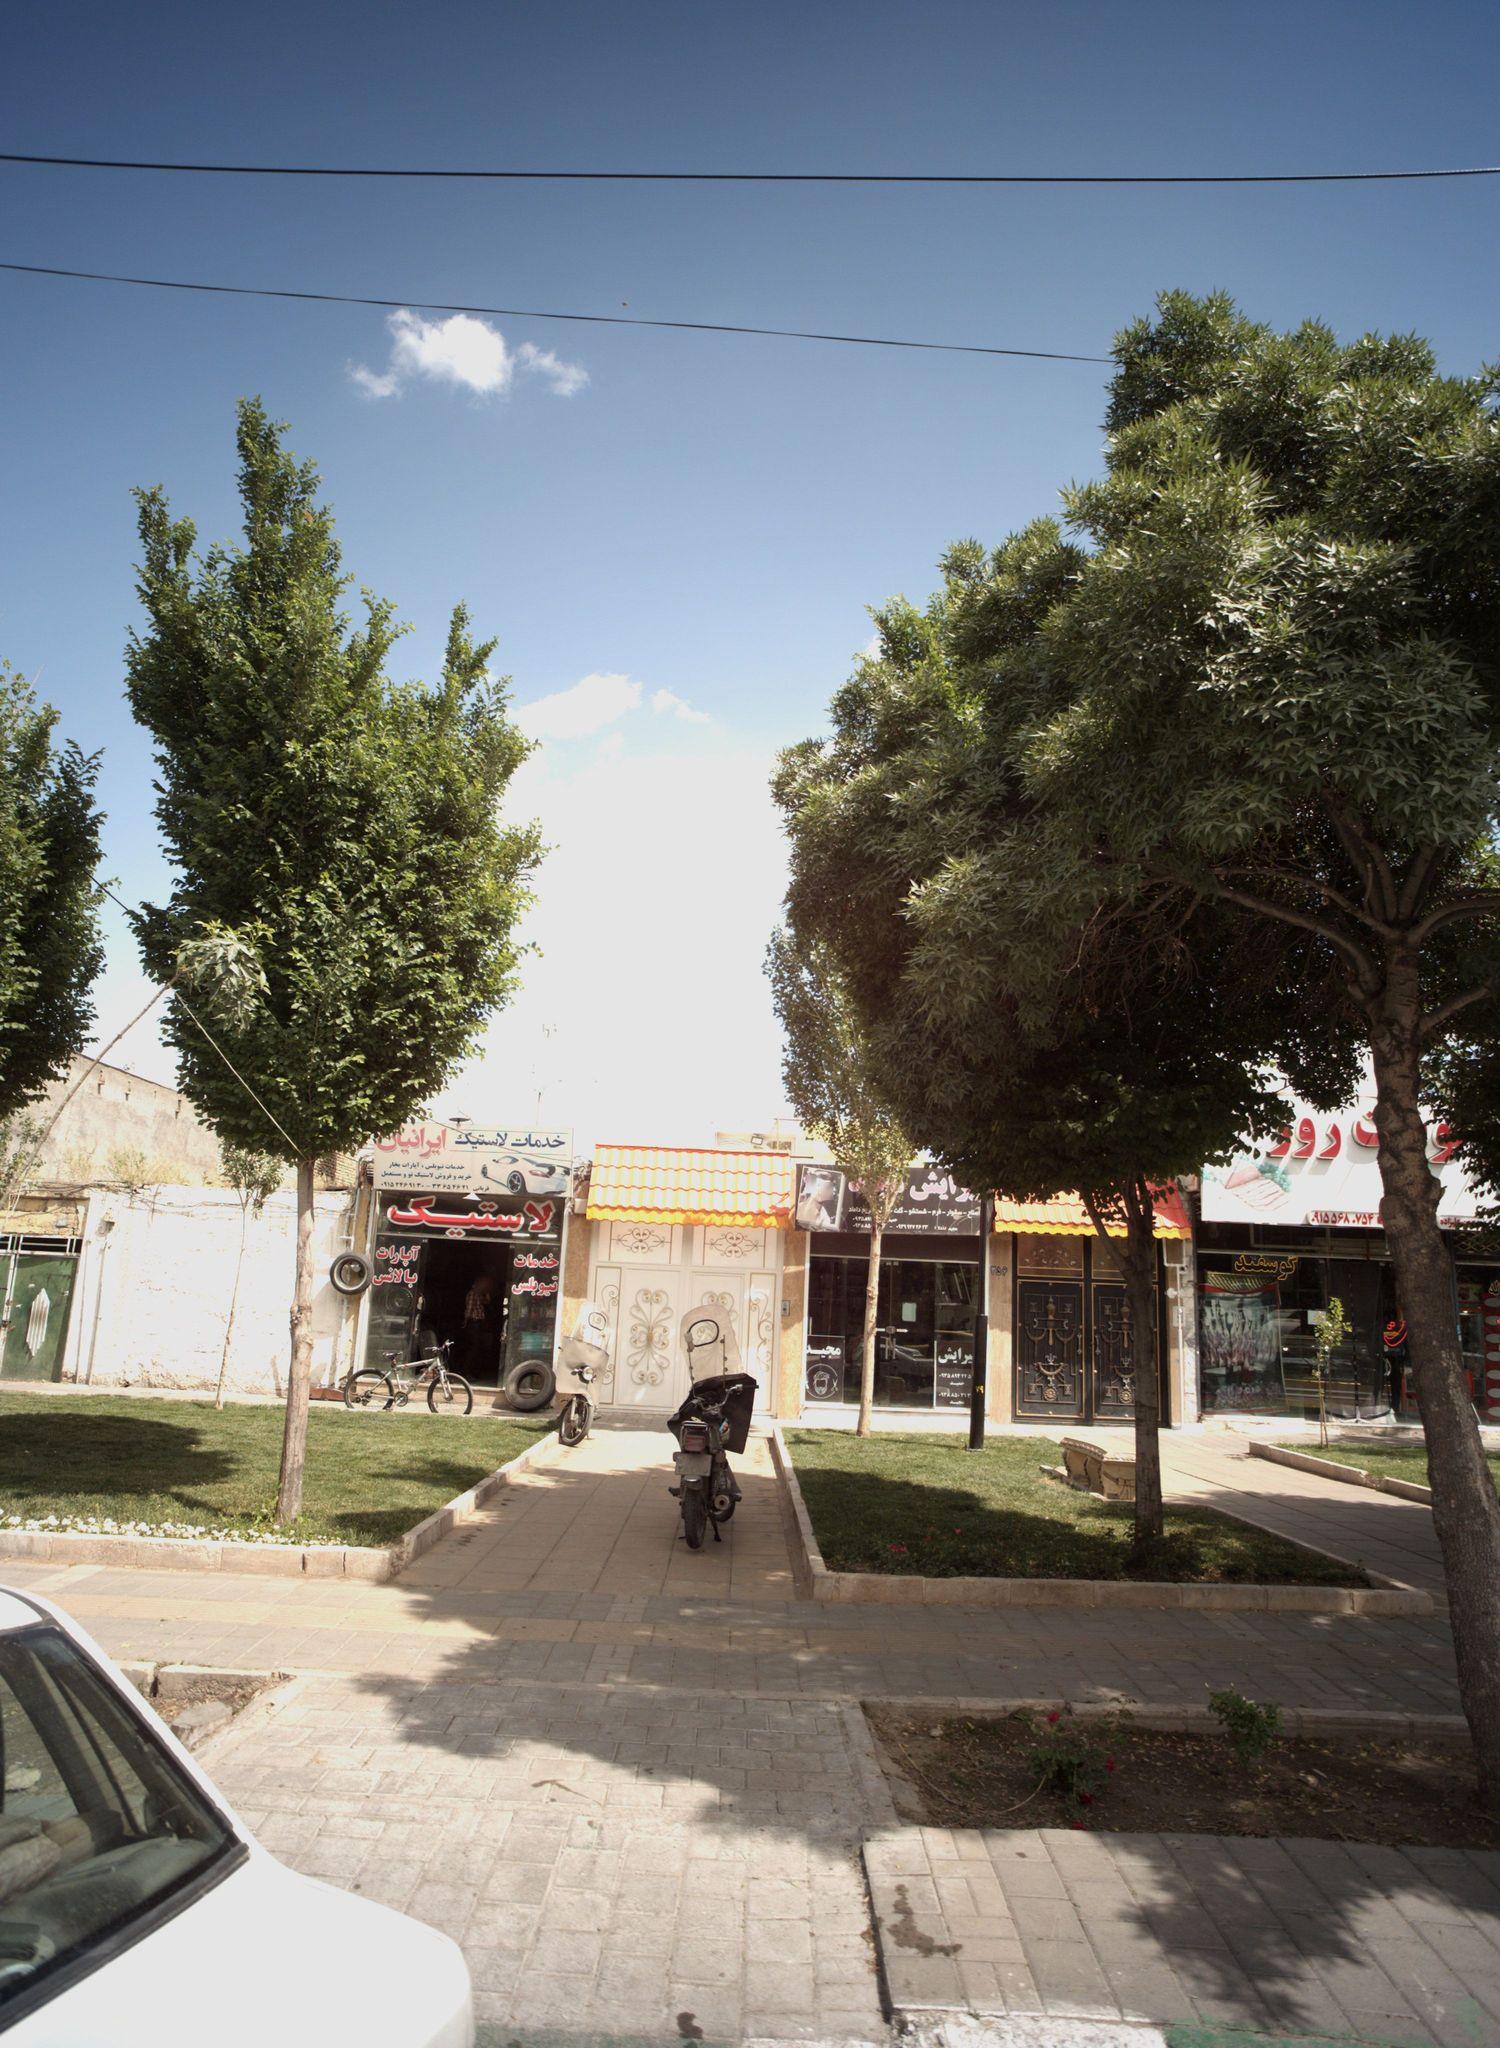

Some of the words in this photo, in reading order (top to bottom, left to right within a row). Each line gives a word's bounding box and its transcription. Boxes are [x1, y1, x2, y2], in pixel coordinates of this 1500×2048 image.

[454, 1132, 508, 1150] لاستیک
[510, 1133, 566, 1148] خدمات
[386, 1194, 556, 1238] لاستیک
[375, 1245, 421, 1267] آپارات
[513, 1252, 559, 1268] خدمات
[371, 1267, 418, 1289] بالانس
[511, 1276, 558, 1296] تیوبلس
